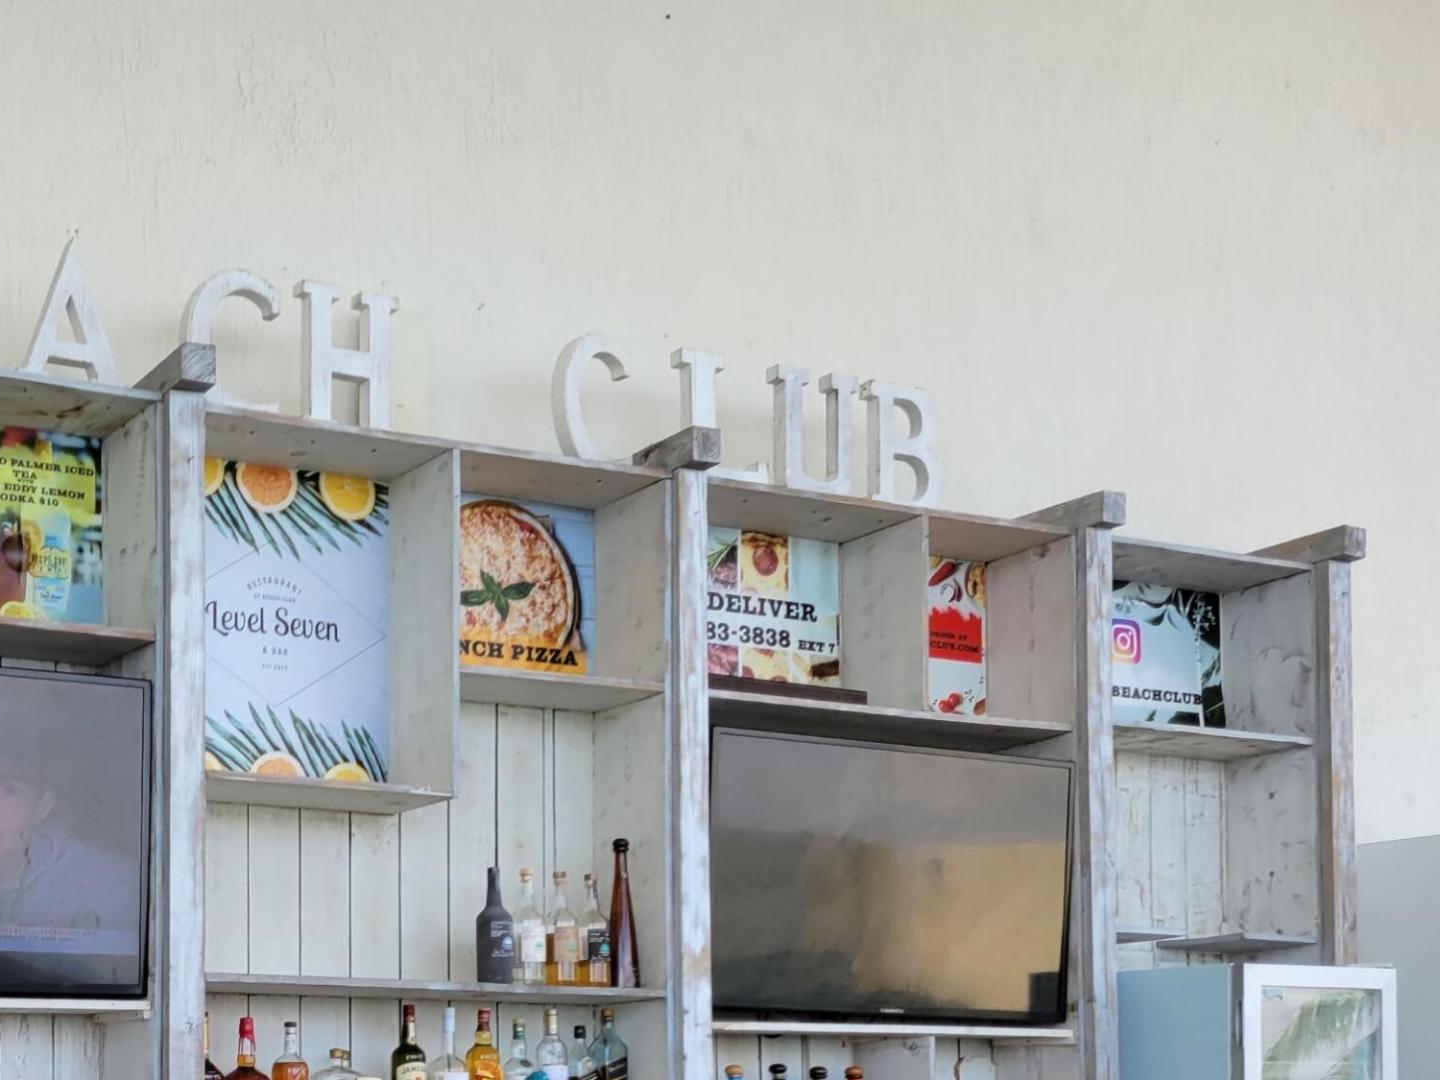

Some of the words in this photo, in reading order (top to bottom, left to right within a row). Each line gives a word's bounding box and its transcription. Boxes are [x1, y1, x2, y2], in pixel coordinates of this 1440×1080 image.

[551, 332, 945, 502] CLUB
[10, 458, 62, 472] PALMER
[65, 466, 95, 477] ICED
[12, 469, 38, 480] TEA
[4, 484, 38, 495] EDDY
[41, 487, 85, 500] LEMON
[246, 576, 303, 597] RESTAURANT
[707, 592, 818, 622] DELIVER
[205, 600, 267, 637] Level
[274, 607, 340, 643] Seven
[511, 644, 578, 667] PIZZA
[798, 639, 826, 652] EXT
[1112, 686, 1201, 705] BEACHCLUB
